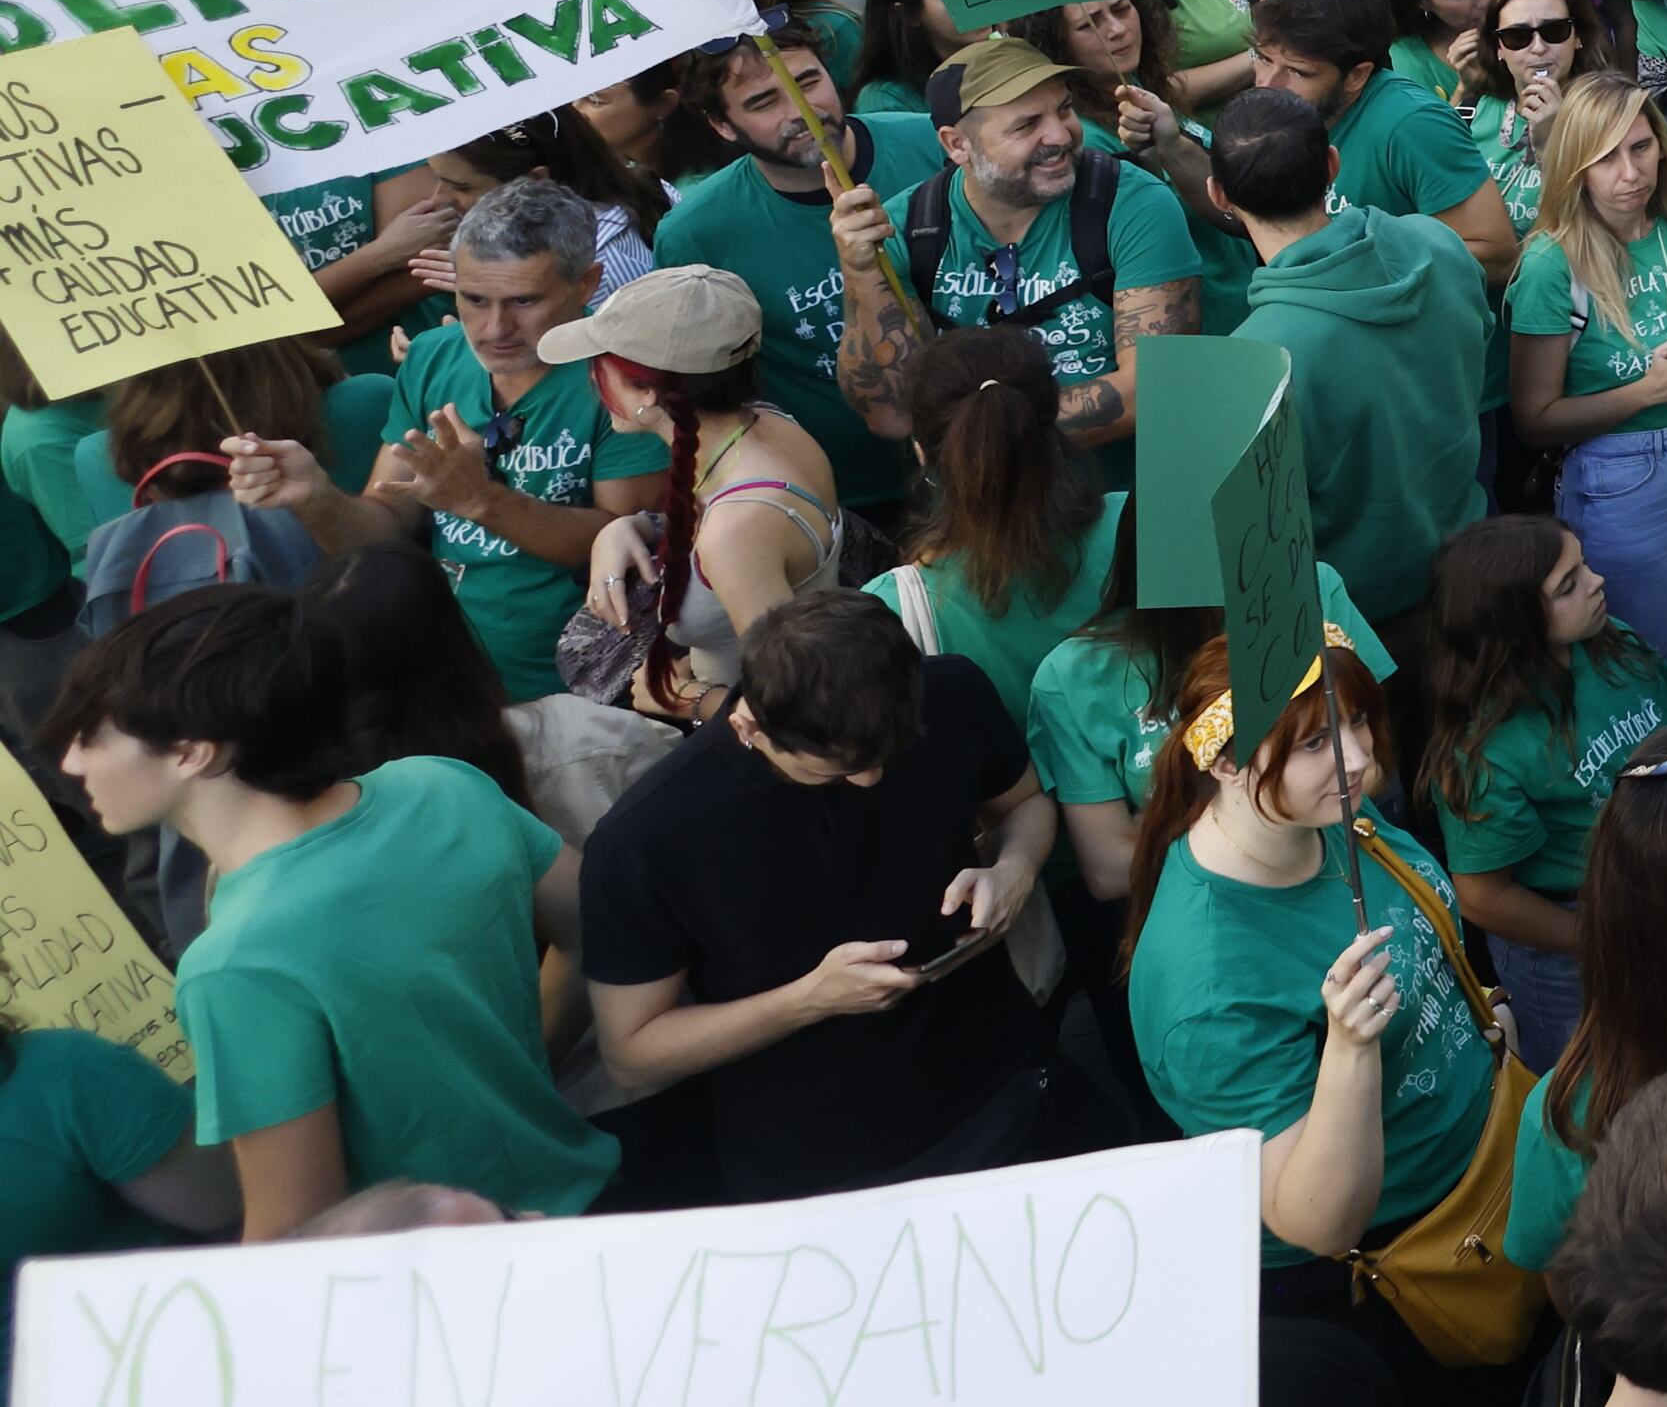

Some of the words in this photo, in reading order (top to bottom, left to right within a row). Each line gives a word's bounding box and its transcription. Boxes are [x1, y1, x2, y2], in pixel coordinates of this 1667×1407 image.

[31, 240, 201, 305] CALIDAD
[59, 260, 296, 355] EDUCATIVA
[320, 1261, 514, 1407] EN
[596, 1189, 1141, 1407] VERANO
